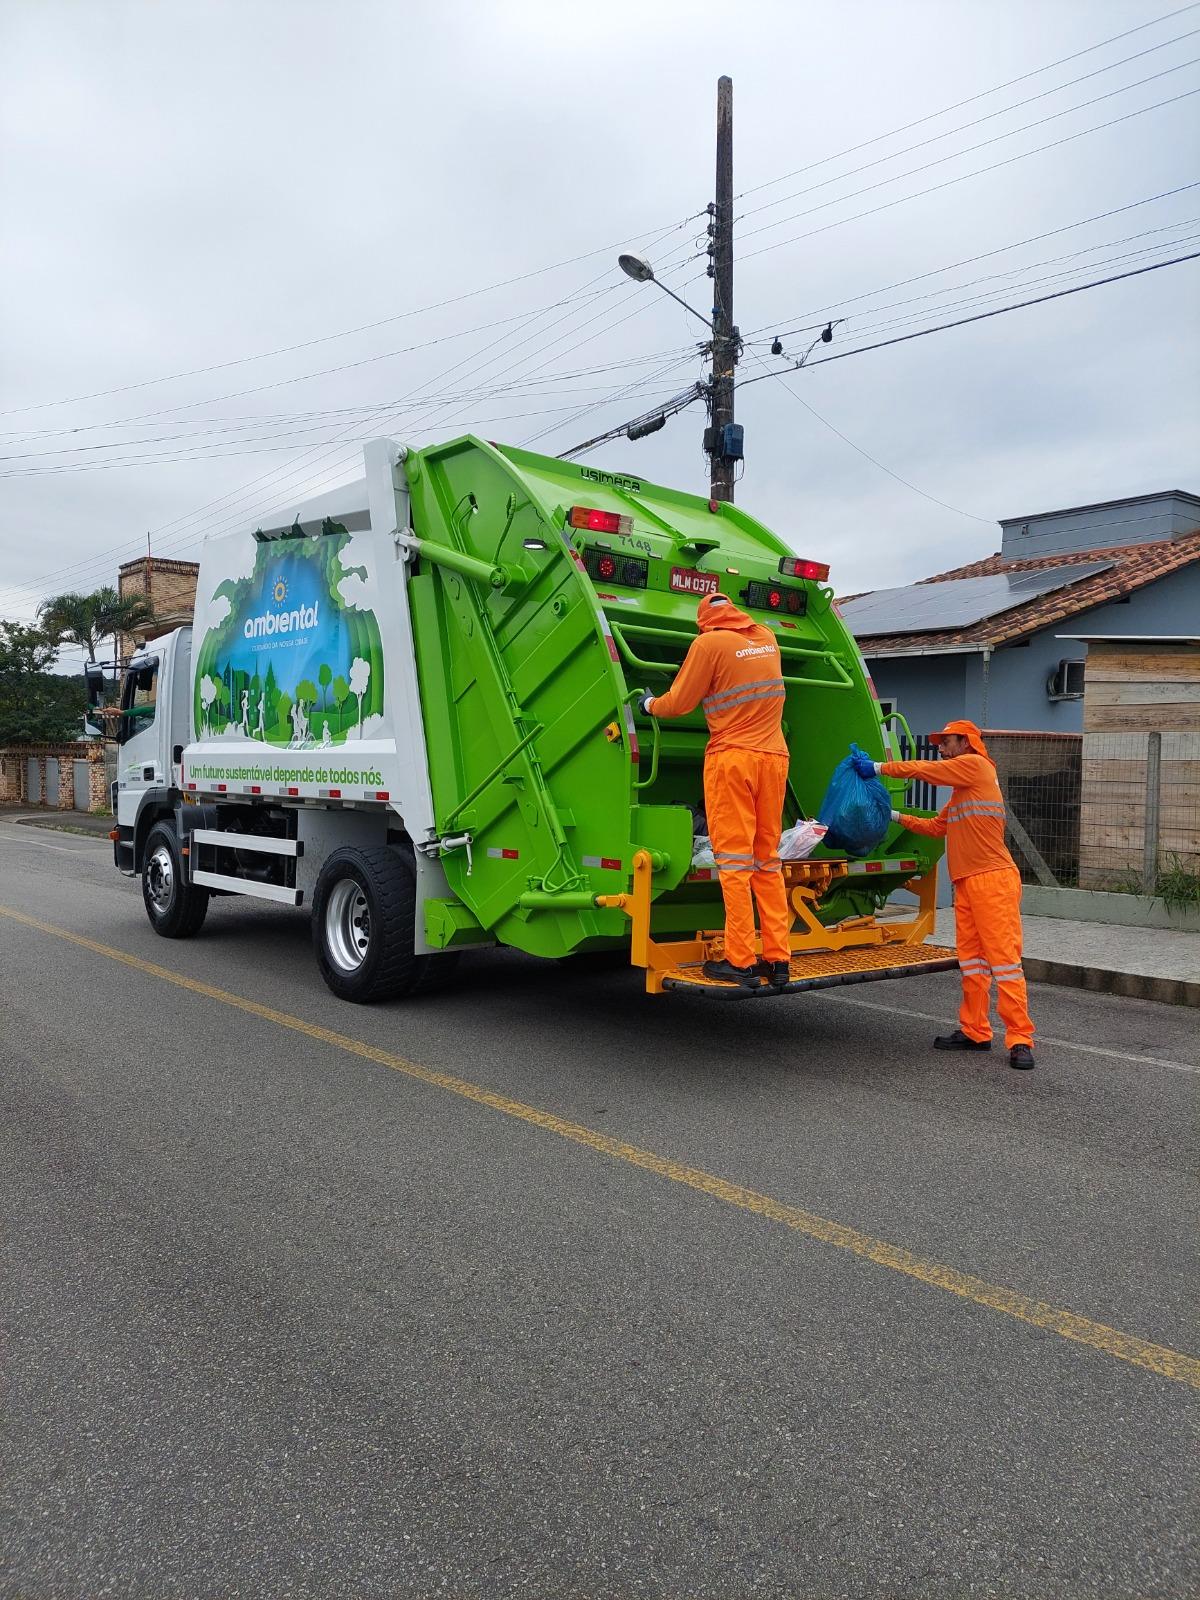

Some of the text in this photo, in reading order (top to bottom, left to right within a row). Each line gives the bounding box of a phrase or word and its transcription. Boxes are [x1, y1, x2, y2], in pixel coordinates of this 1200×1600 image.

[580, 467, 640, 492] usimeca
[618, 535, 652, 552] 7148
[672, 574, 717, 594] MLM 0375
[244, 600, 319, 638] ambiental
[735, 644, 777, 658] ambiental
[189, 763, 385, 787] Um futuro sustentável depende de todos nós.
